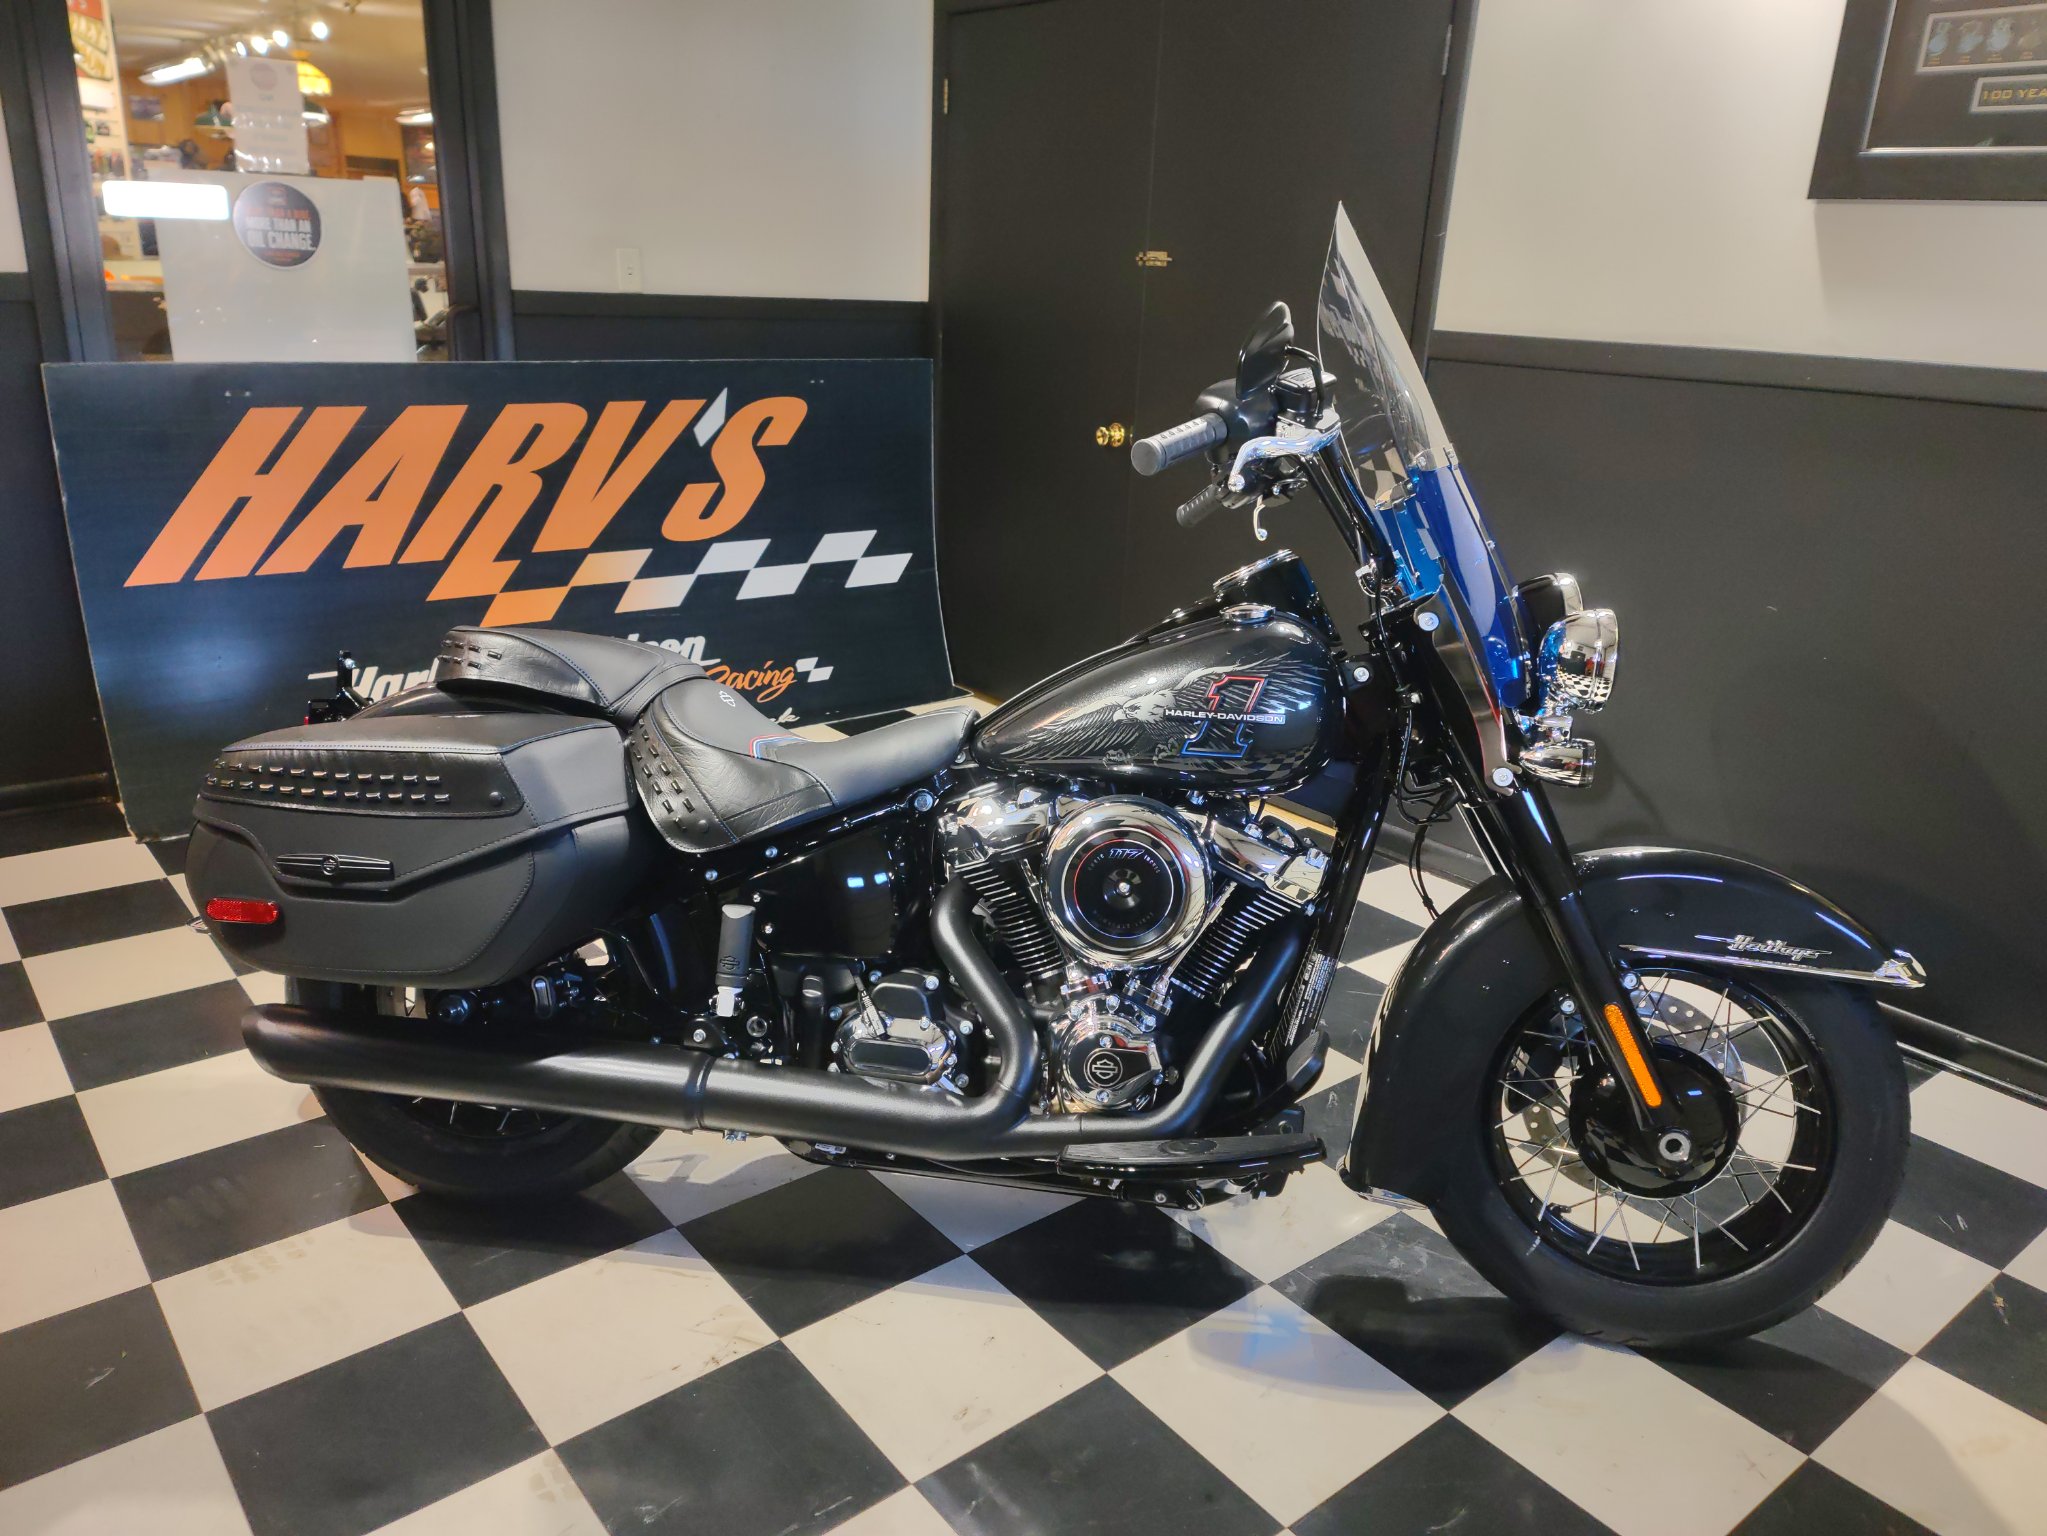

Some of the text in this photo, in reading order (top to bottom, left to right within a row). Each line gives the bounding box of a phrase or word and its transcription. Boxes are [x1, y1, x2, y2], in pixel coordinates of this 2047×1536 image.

[1983, 89, 2013, 100] 100
[124, 387, 808, 601] HARV'S
[1165, 709, 1283, 723] HARLEY-DAVIDSON
[1727, 934, 1832, 961] Heritage
